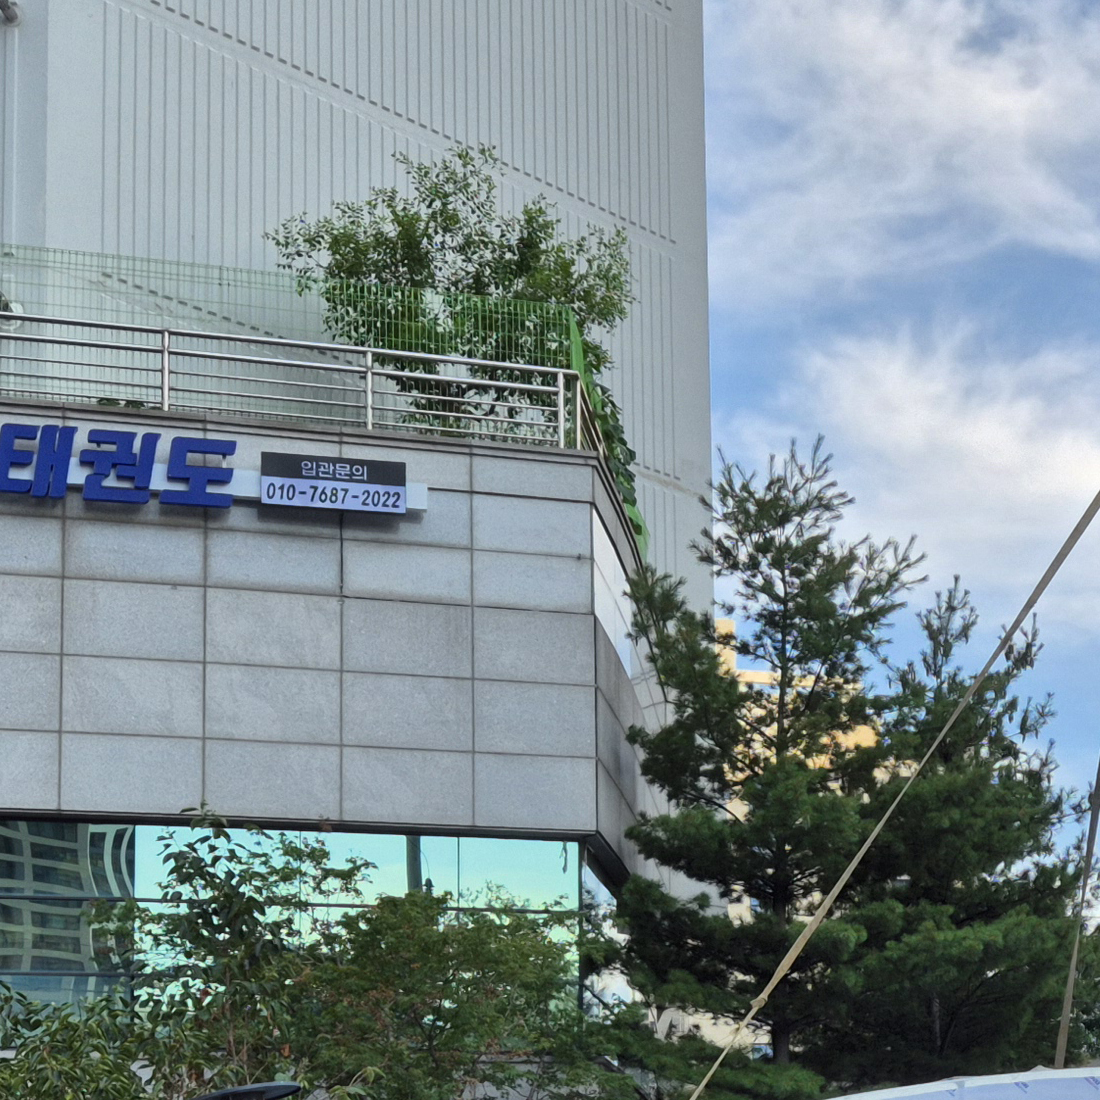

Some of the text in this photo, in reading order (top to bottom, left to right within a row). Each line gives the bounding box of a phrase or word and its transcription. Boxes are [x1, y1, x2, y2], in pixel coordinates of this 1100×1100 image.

[0, 422, 237, 509] 태권도
[300, 460, 368, 482] 입관문의
[265, 482, 401, 510] 010-7687-2022
